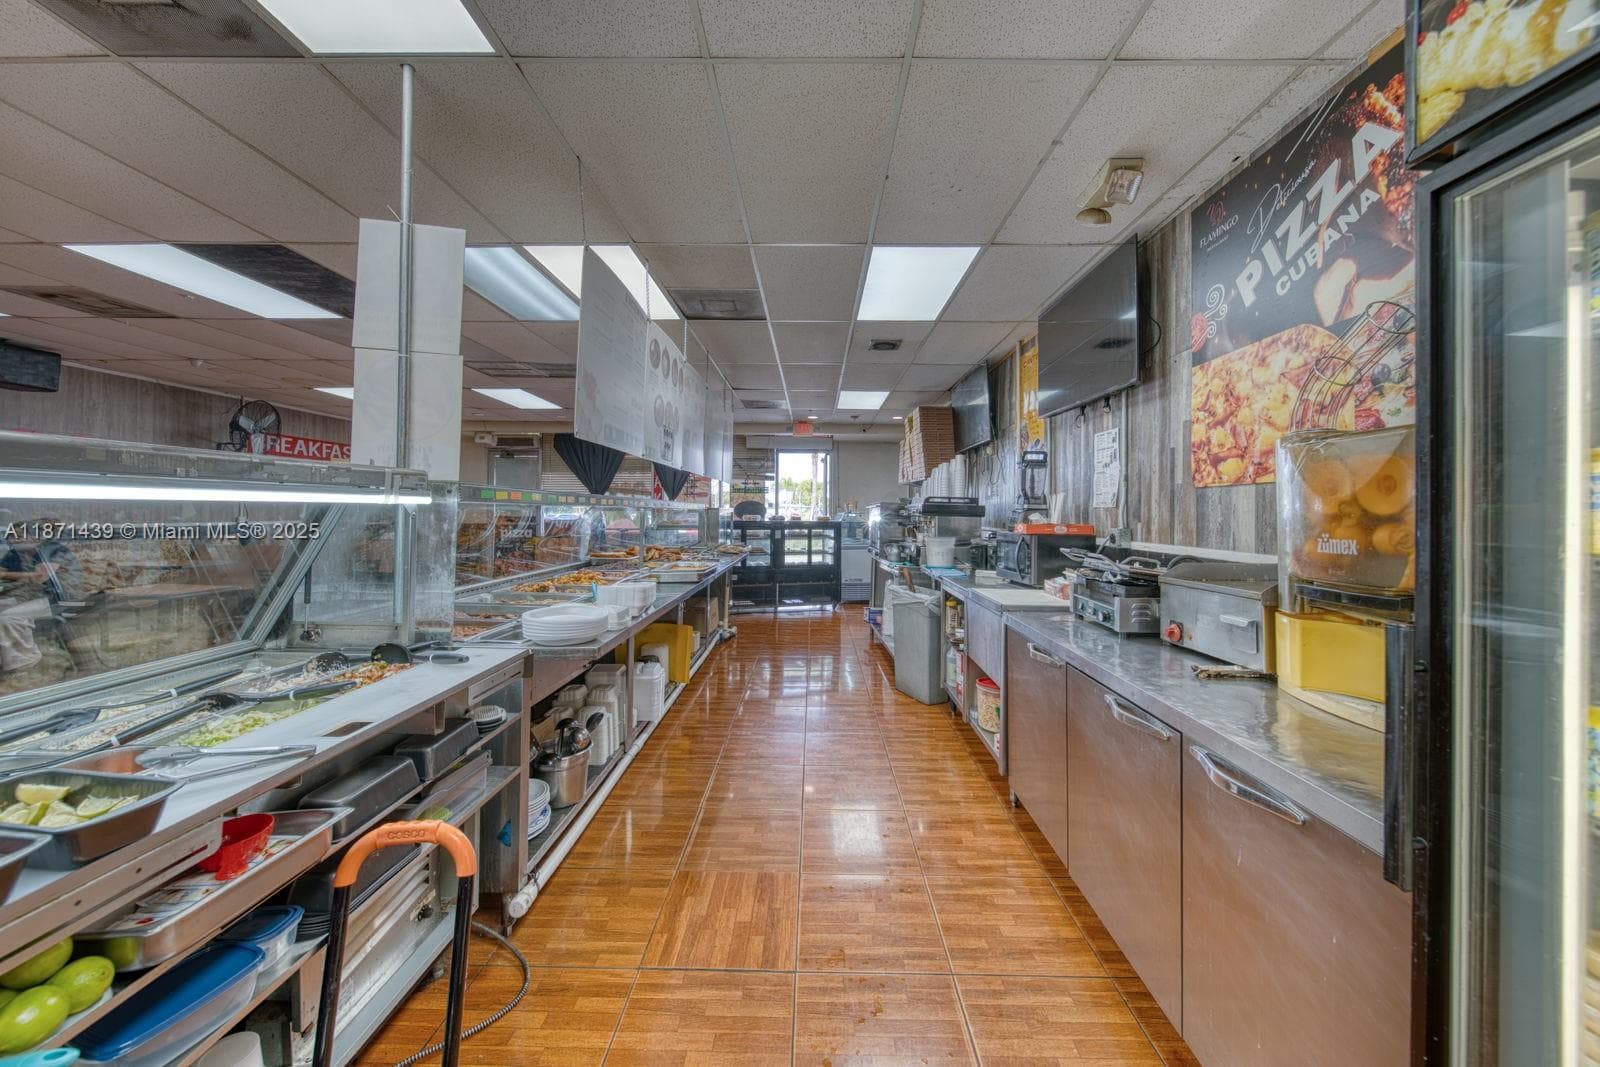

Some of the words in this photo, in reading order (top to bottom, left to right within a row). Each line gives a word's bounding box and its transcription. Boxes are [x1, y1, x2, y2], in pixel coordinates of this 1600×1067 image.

[1199, 214, 1239, 248] FLAMINGO
[1235, 122, 1402, 308] PIZZA
[1275, 188, 1381, 296] CUBANA
